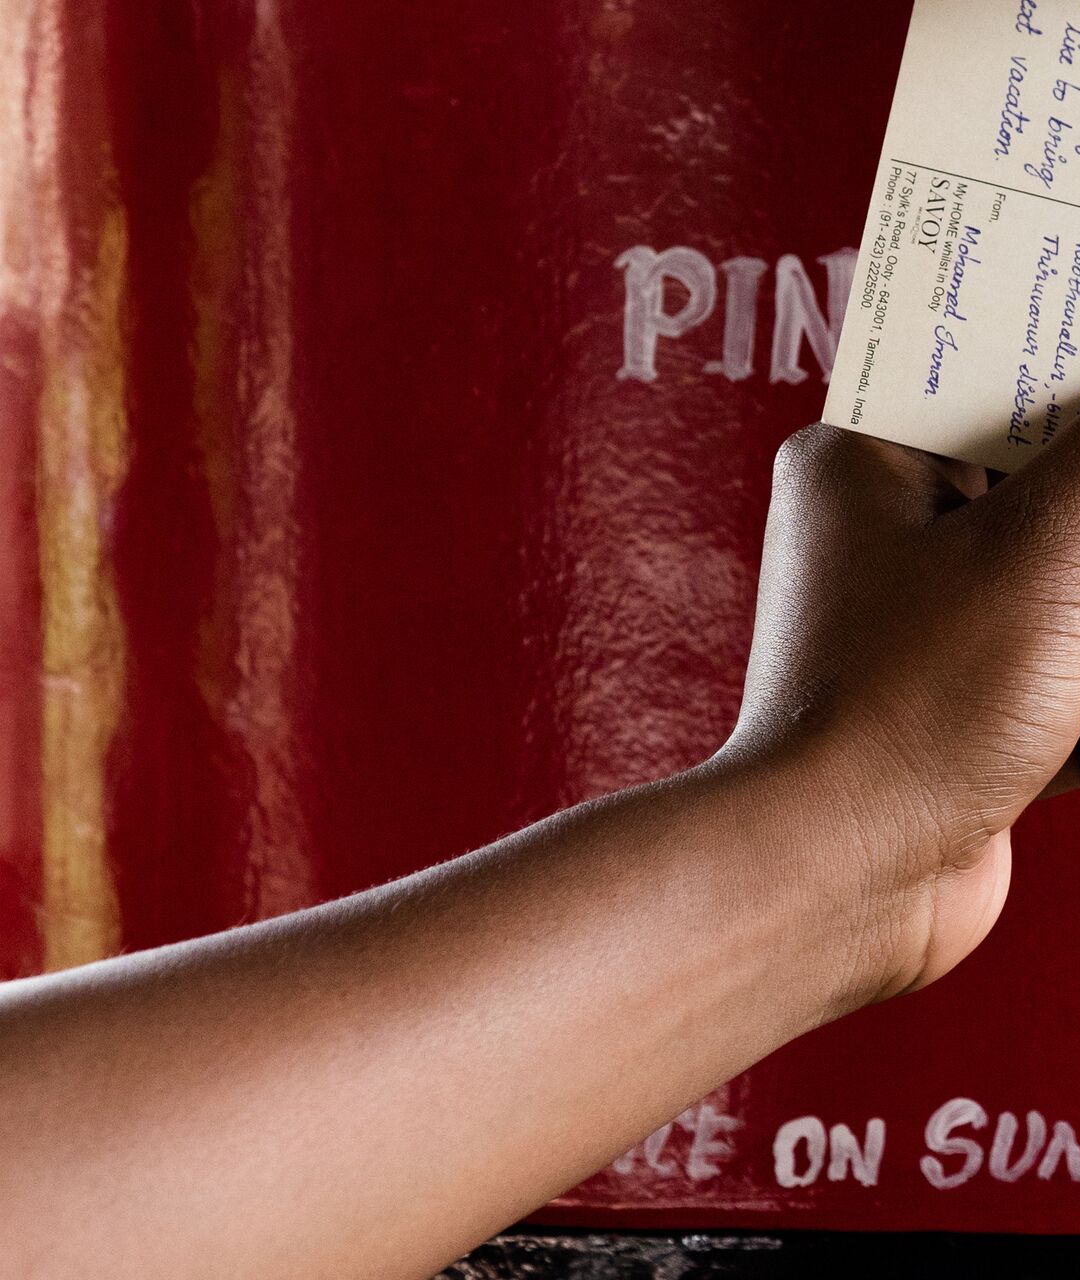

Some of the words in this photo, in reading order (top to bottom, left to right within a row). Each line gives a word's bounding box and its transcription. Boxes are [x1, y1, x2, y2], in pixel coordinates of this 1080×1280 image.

[993, 56, 1030, 160] vacation.
[1023, 115, 1073, 189] bring
[884, 166, 902, 201] Phone
[904, 170, 917, 185] 77
[952, 182, 968, 199] My
[896, 185, 913, 217] Sylk's
[917, 176, 949, 254] SAVOY
[988, 191, 1006, 222] From,
[887, 219, 906, 251] Road,
[945, 201, 963, 238] HOME
[881, 254, 898, 281] Ooty
[938, 240, 953, 271] whilst
[942, 225, 981, 321] Mohamed
[859, 260, 881, 309] 2225500.
[935, 272, 948, 283] in
[612, 244, 860, 386] PIN
[869, 289, 890, 332] 643001,
[927, 285, 945, 312] Ooty
[855, 337, 880, 394] Tamilnadu,
[849, 397, 866, 425] India
[612, 1104, 742, 1181] CE
[774, 1114, 886, 1188] ON
